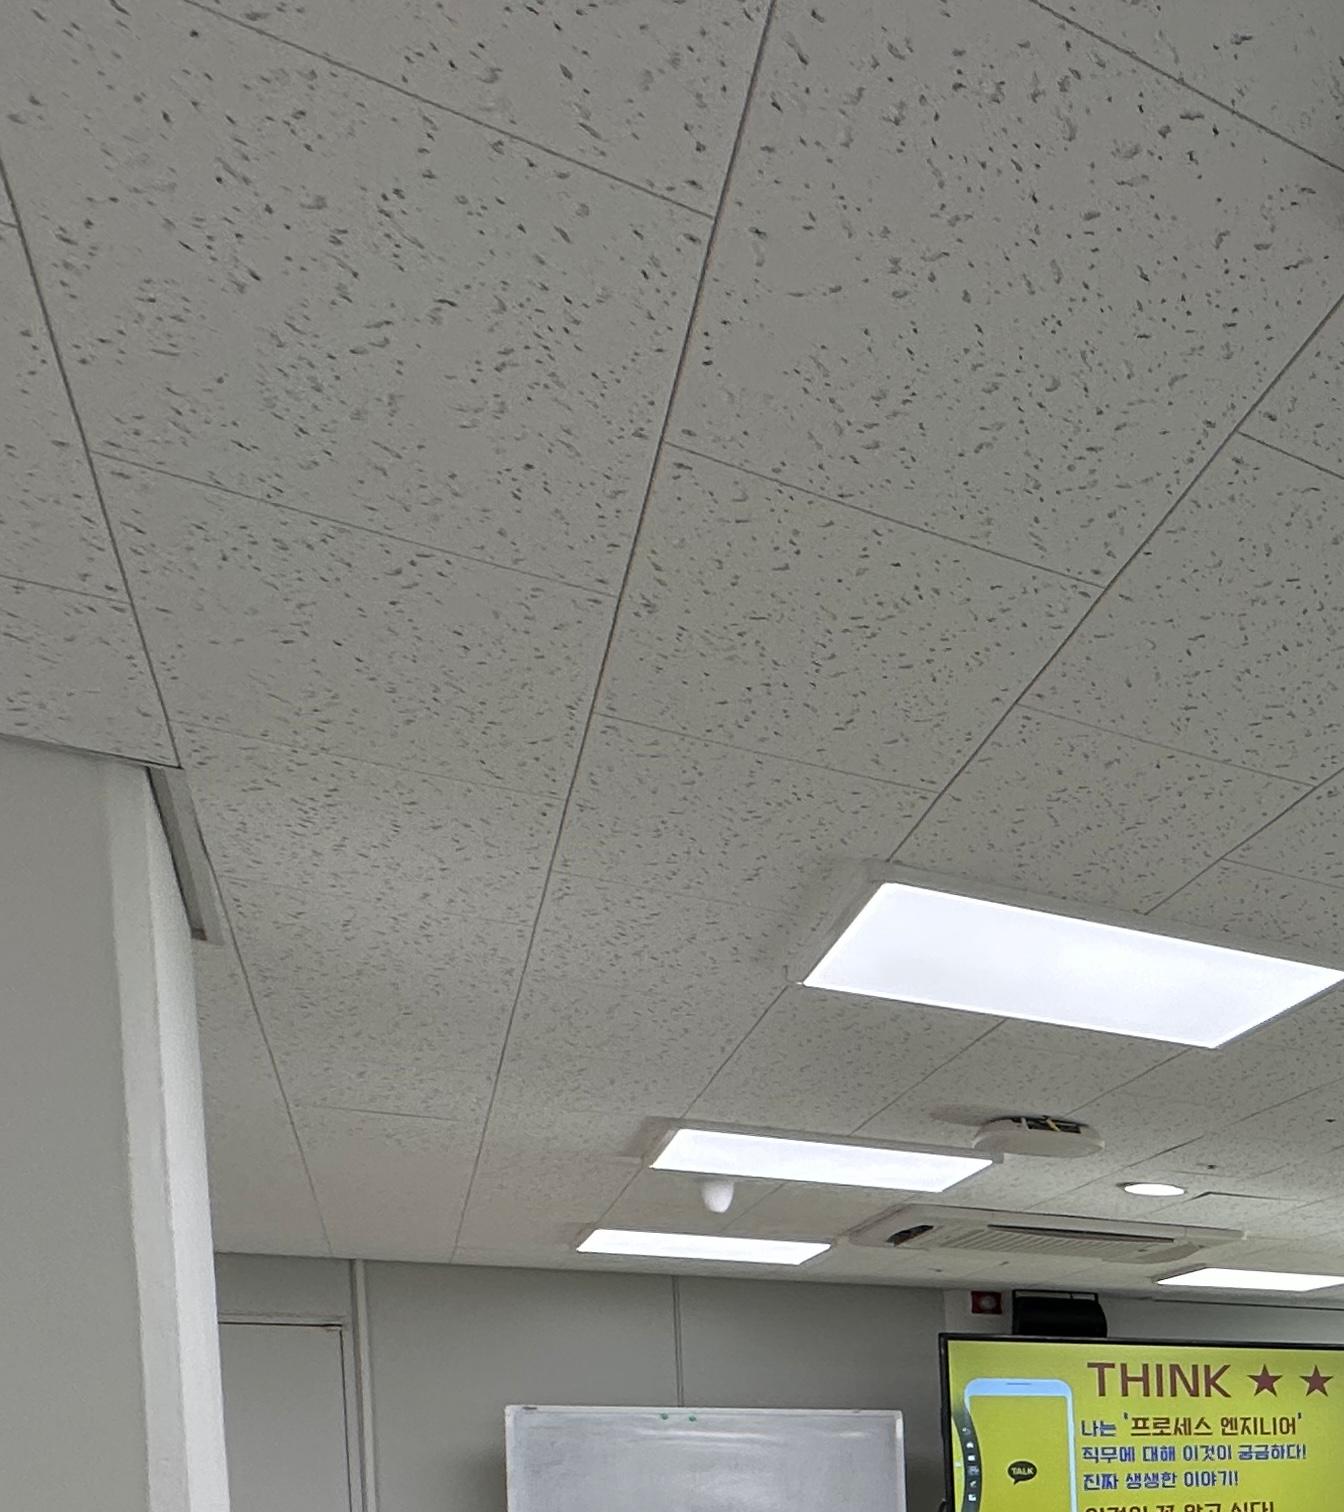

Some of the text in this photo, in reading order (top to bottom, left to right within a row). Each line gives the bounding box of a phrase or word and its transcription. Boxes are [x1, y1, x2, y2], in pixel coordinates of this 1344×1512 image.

[1087, 1362, 1232, 1398] THINK
[1081, 1419, 1117, 1437] 나는
[1082, 1443, 1307, 1463] 직무에 대해 이것이 궁금하다!
[1083, 1470, 1239, 1491] 진짜 생생한 이야기!
